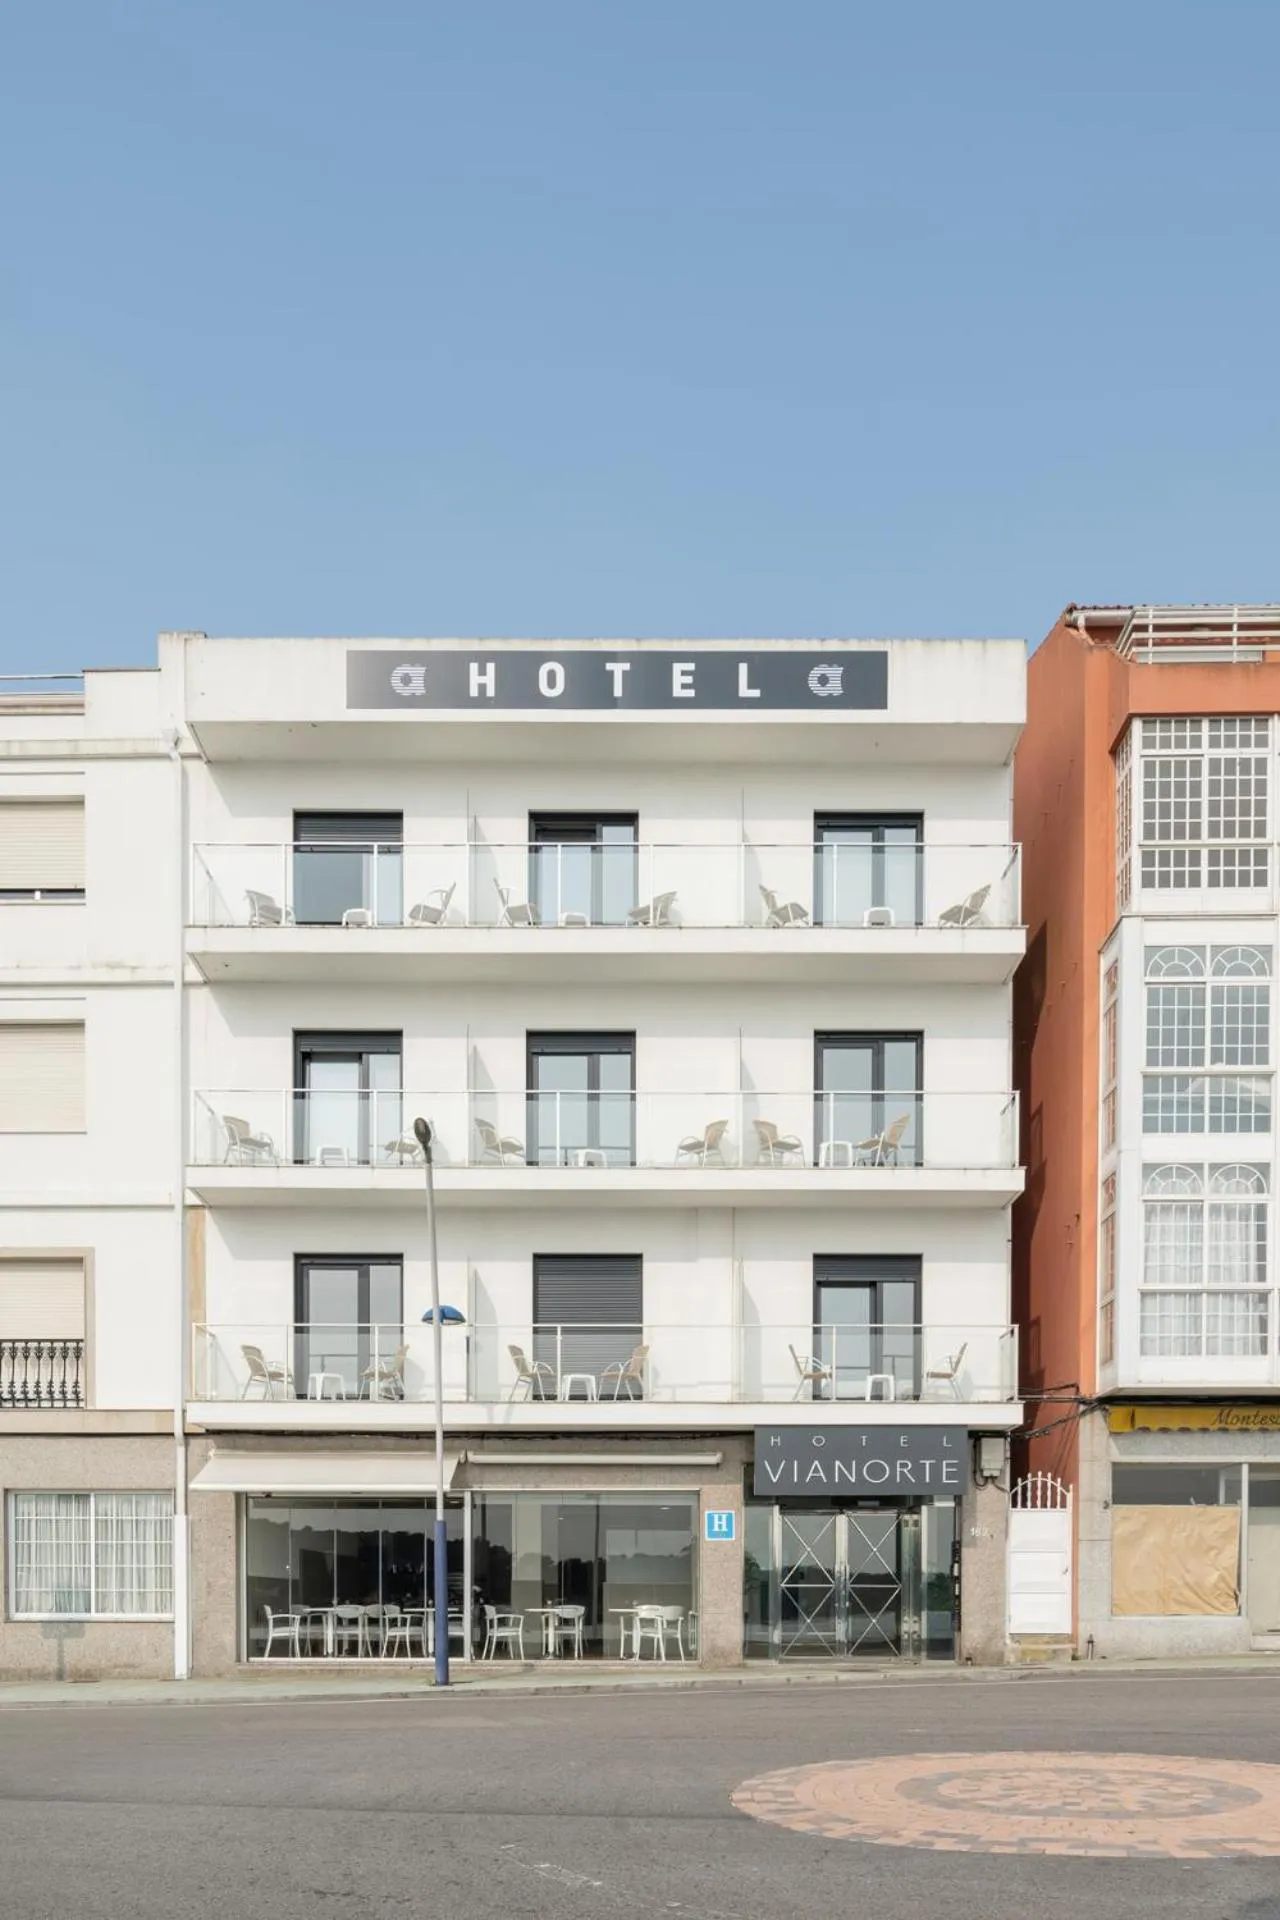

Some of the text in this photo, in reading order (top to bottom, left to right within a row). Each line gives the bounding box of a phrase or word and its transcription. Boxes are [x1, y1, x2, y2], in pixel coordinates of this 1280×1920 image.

[469, 662, 760, 698] HOTEL
[770, 1435, 952, 1447] HOTEL
[764, 1459, 959, 1483] VIANORTE
[712, 1513, 728, 1531] H
